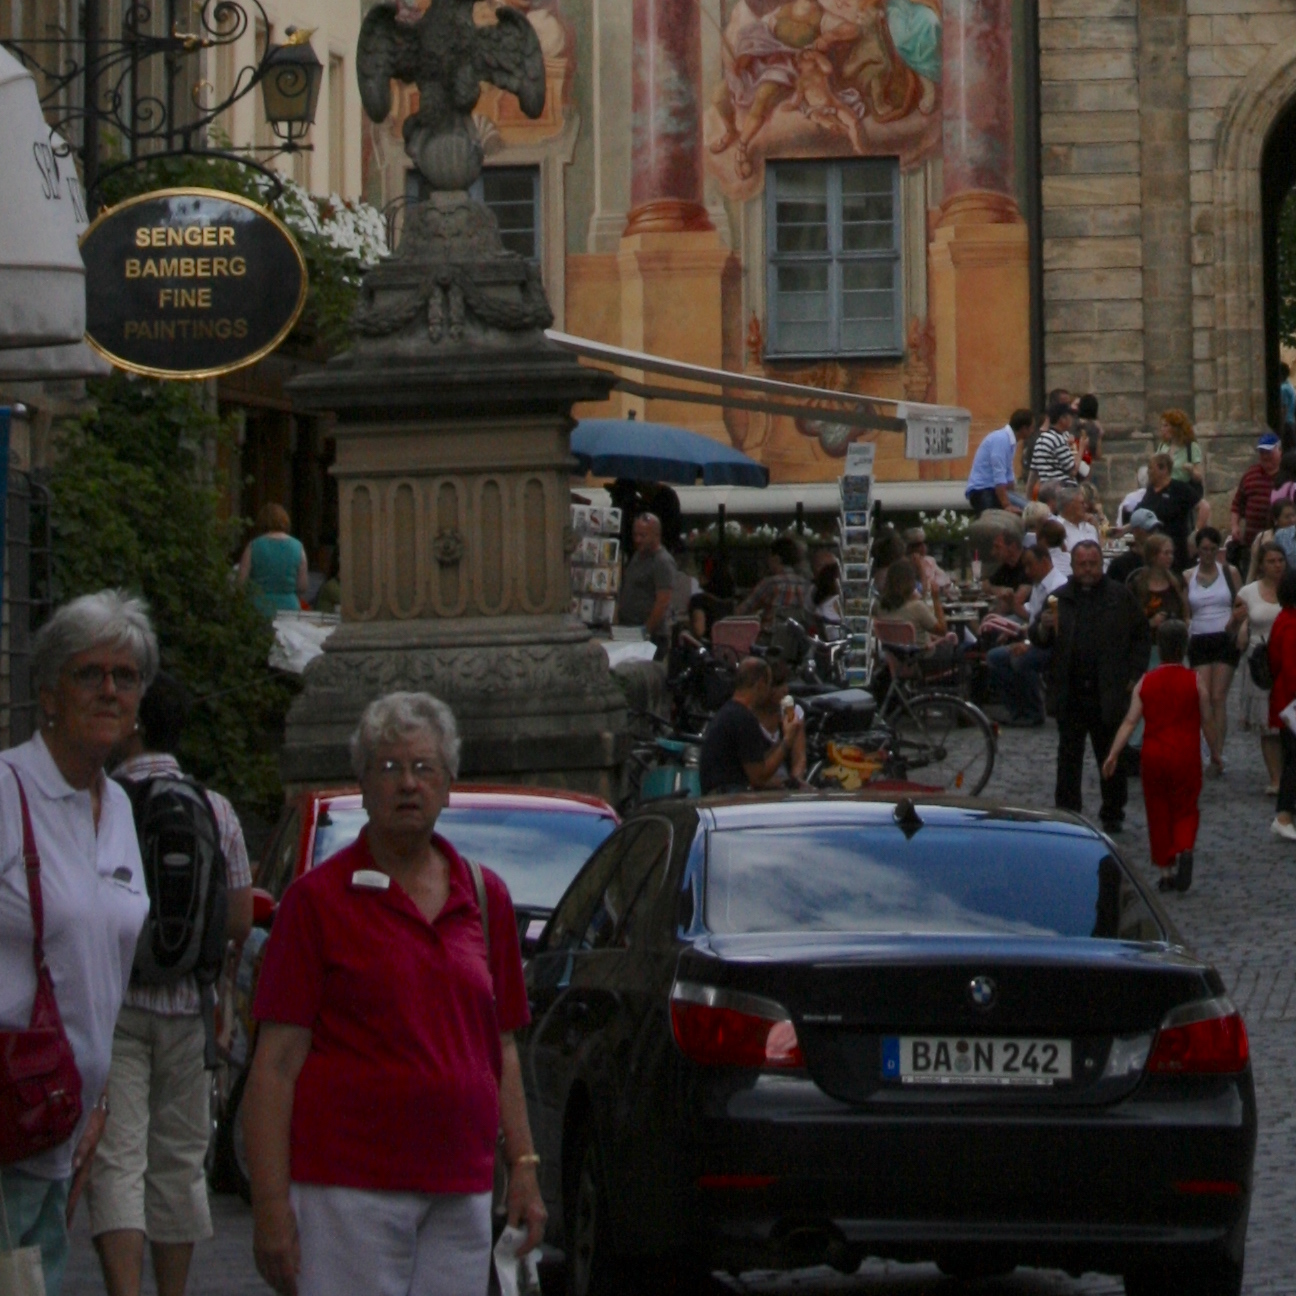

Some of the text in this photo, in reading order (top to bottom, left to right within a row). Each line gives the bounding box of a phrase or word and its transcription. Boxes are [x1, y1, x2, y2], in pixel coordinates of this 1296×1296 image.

[135, 226, 236, 247] SENGER
[125, 256, 247, 278] BAMBERG
[158, 288, 212, 308] FINE
[124, 318, 248, 340] PAINTINGS
[912, 1041, 1059, 1074] BA N 242
